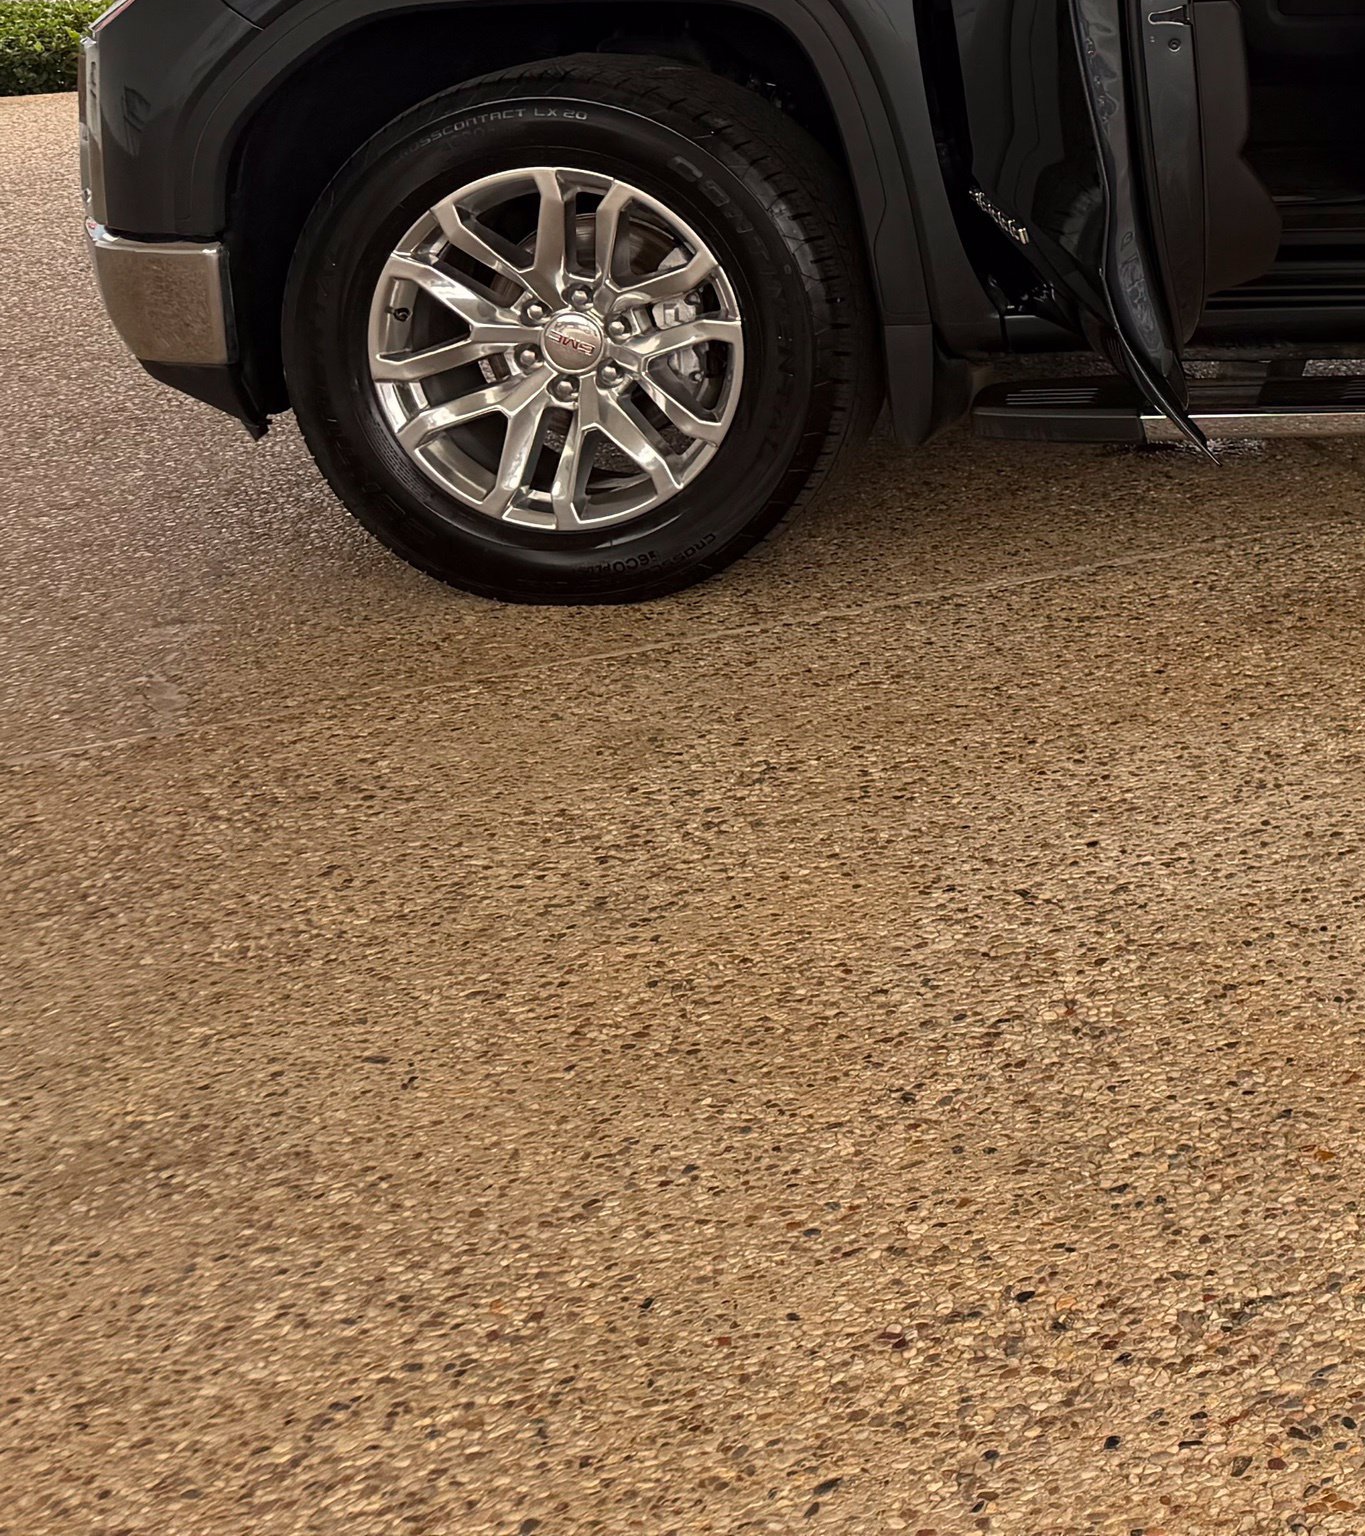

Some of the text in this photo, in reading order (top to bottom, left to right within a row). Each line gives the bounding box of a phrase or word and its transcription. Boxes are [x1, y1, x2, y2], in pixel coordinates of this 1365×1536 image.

[398, 108, 526, 159] OSSCONTACT
[534, 108, 557, 118] LX
[562, 109, 588, 120] 20
[548, 330, 596, 357] GMC
